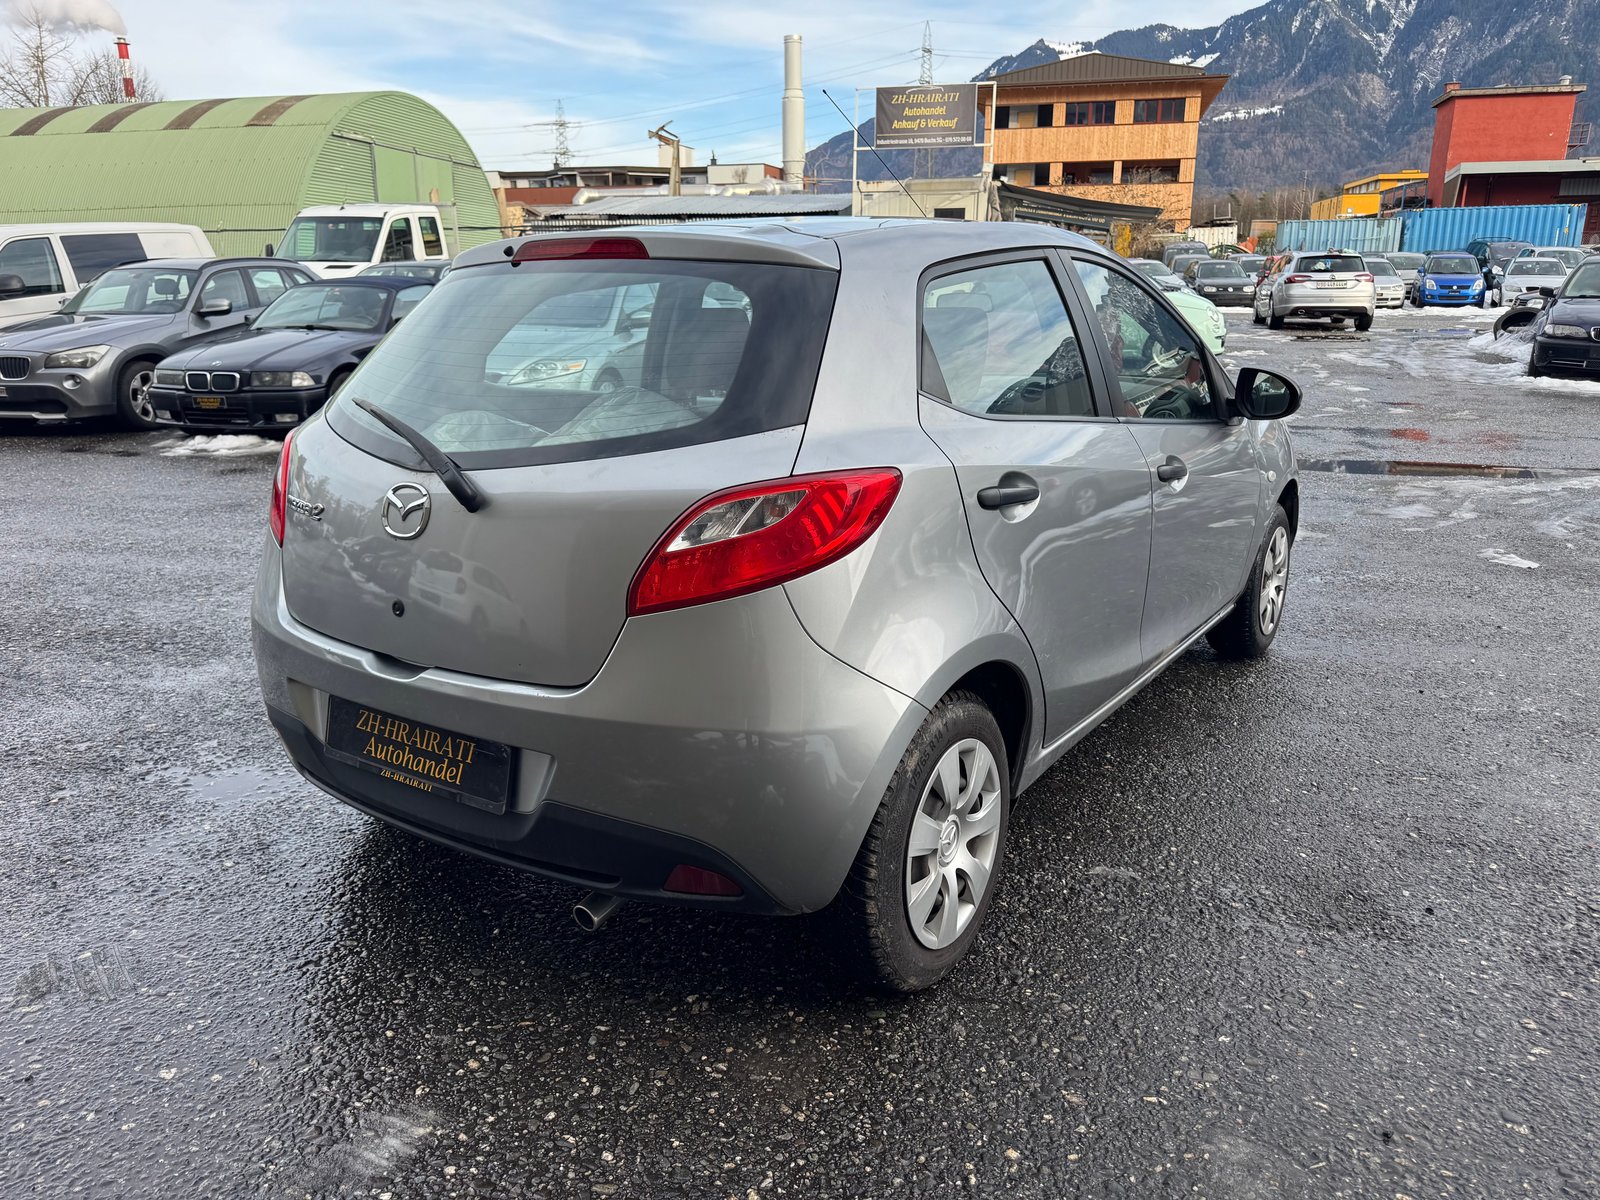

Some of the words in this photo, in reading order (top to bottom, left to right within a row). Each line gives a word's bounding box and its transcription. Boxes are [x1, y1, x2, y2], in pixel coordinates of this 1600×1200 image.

[891, 92, 960, 104] ZH-HRAIRATI
[903, 106, 946, 117] Autohandel
[892, 119, 921, 131] Ankauf
[920, 119, 927, 128] &
[927, 117, 958, 129] Verkauf
[356, 709, 477, 764] ZH-HRAIRATI
[363, 736, 463, 785] Autohandel
[380, 768, 433, 792] ZH-HRAIRATI
